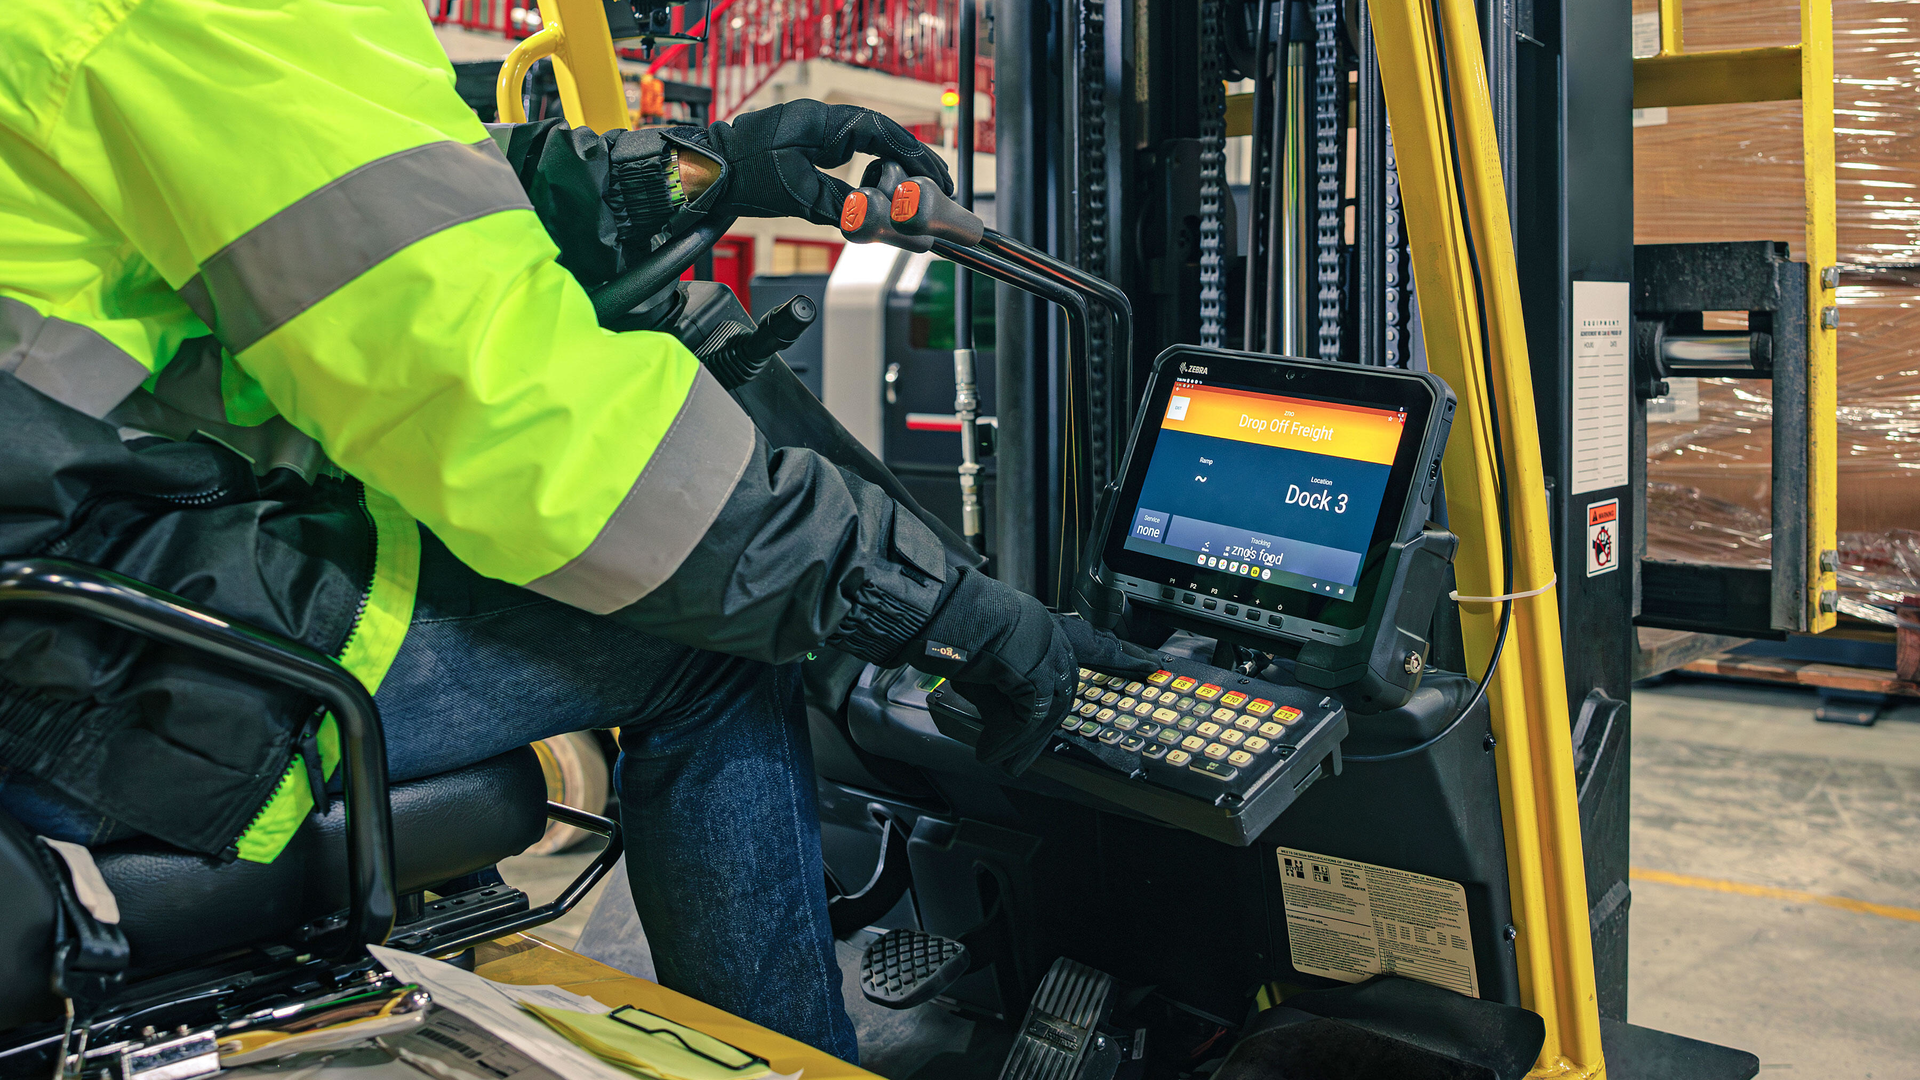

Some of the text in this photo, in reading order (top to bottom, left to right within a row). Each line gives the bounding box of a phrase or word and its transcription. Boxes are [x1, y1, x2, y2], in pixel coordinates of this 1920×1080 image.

[1188, 365, 1208, 375] ZEBRA
[1239, 414, 1334, 442] Drop Off Freight
[1199, 456, 1213, 466] Ramp
[1310, 476, 1333, 486] Location
[1285, 484, 1349, 514] Dock 3
[1143, 514, 1160, 523] Service
[1598, 510, 1614, 519] WARNING
[1136, 525, 1160, 538] none
[1250, 537, 1271, 548] Tracking
[1258, 548, 1284, 565] food
[1224, 695, 1240, 703] F10
[1250, 703, 1265, 711] F11
[1276, 711, 1293, 719] F12
